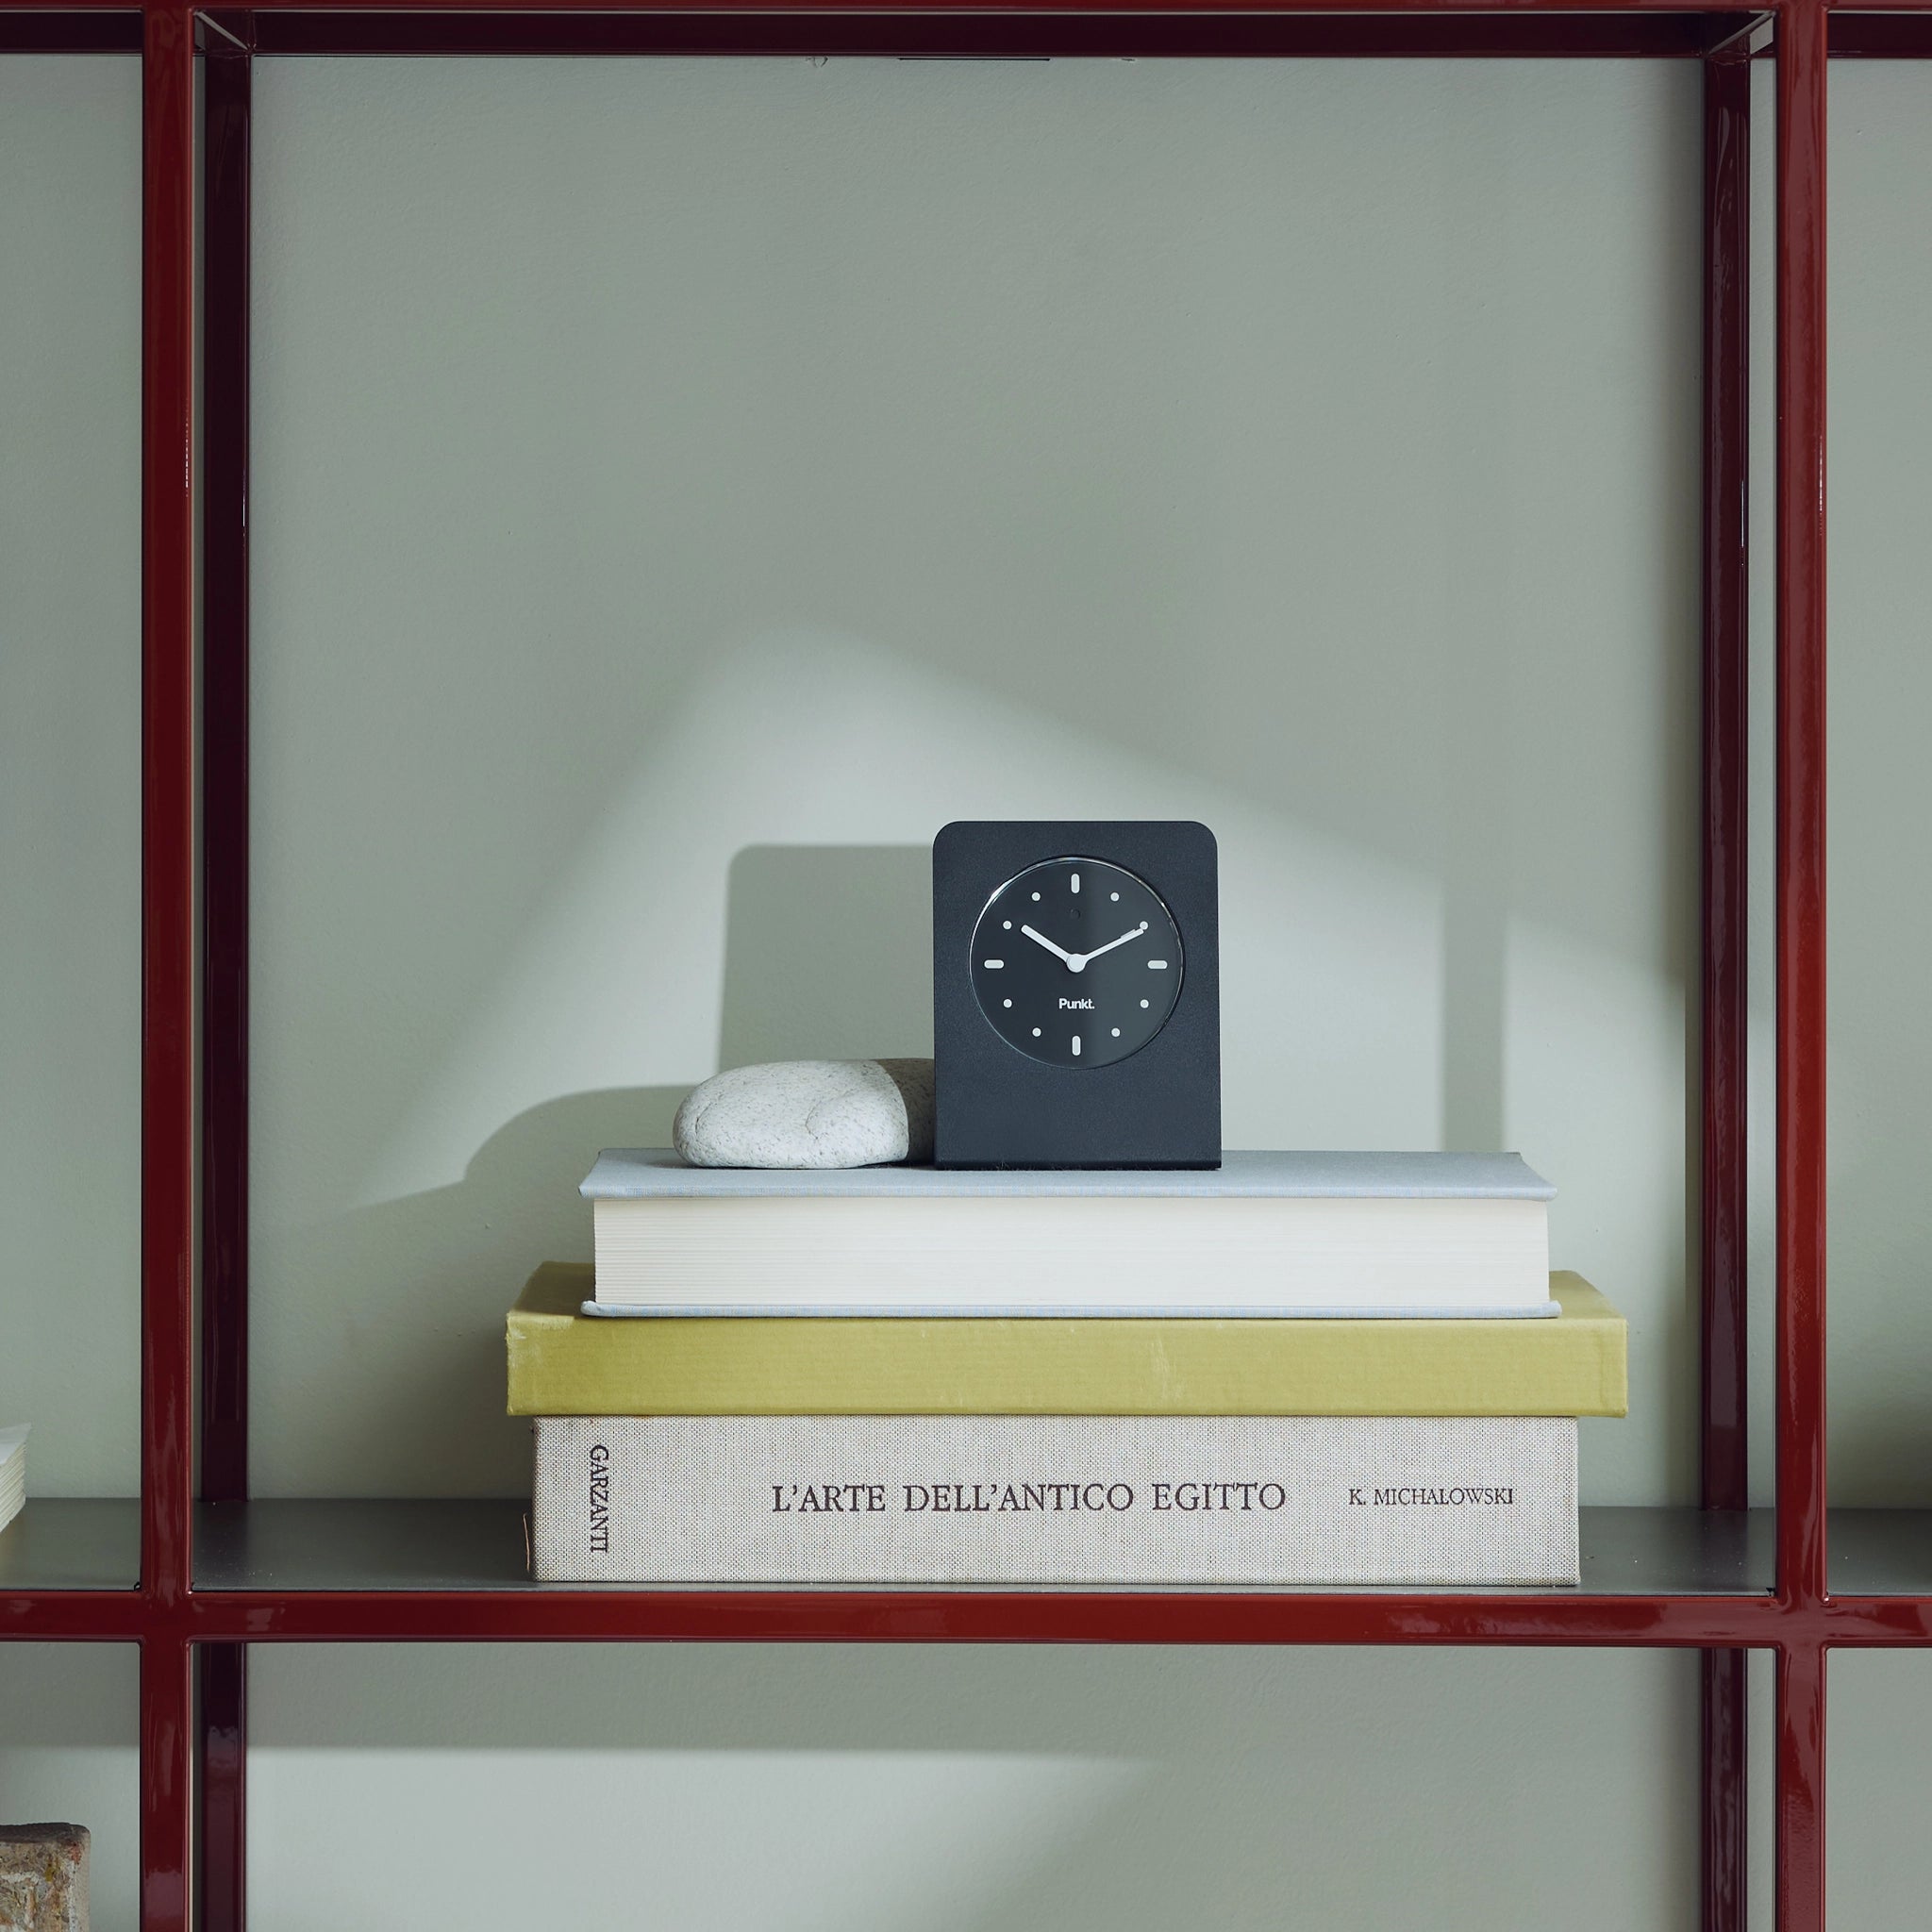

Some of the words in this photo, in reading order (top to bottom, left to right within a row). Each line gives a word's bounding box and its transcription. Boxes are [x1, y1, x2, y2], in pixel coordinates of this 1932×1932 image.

[1058, 997, 1095, 1009] Punkt.
[590, 1444, 609, 1553] GARZANTI
[772, 1484, 886, 1512] L'ARTE
[902, 1483, 1134, 1512] DELL'ANTICO
[1151, 1482, 1286, 1510] EGITTO
[1348, 1488, 1367, 1506] K.
